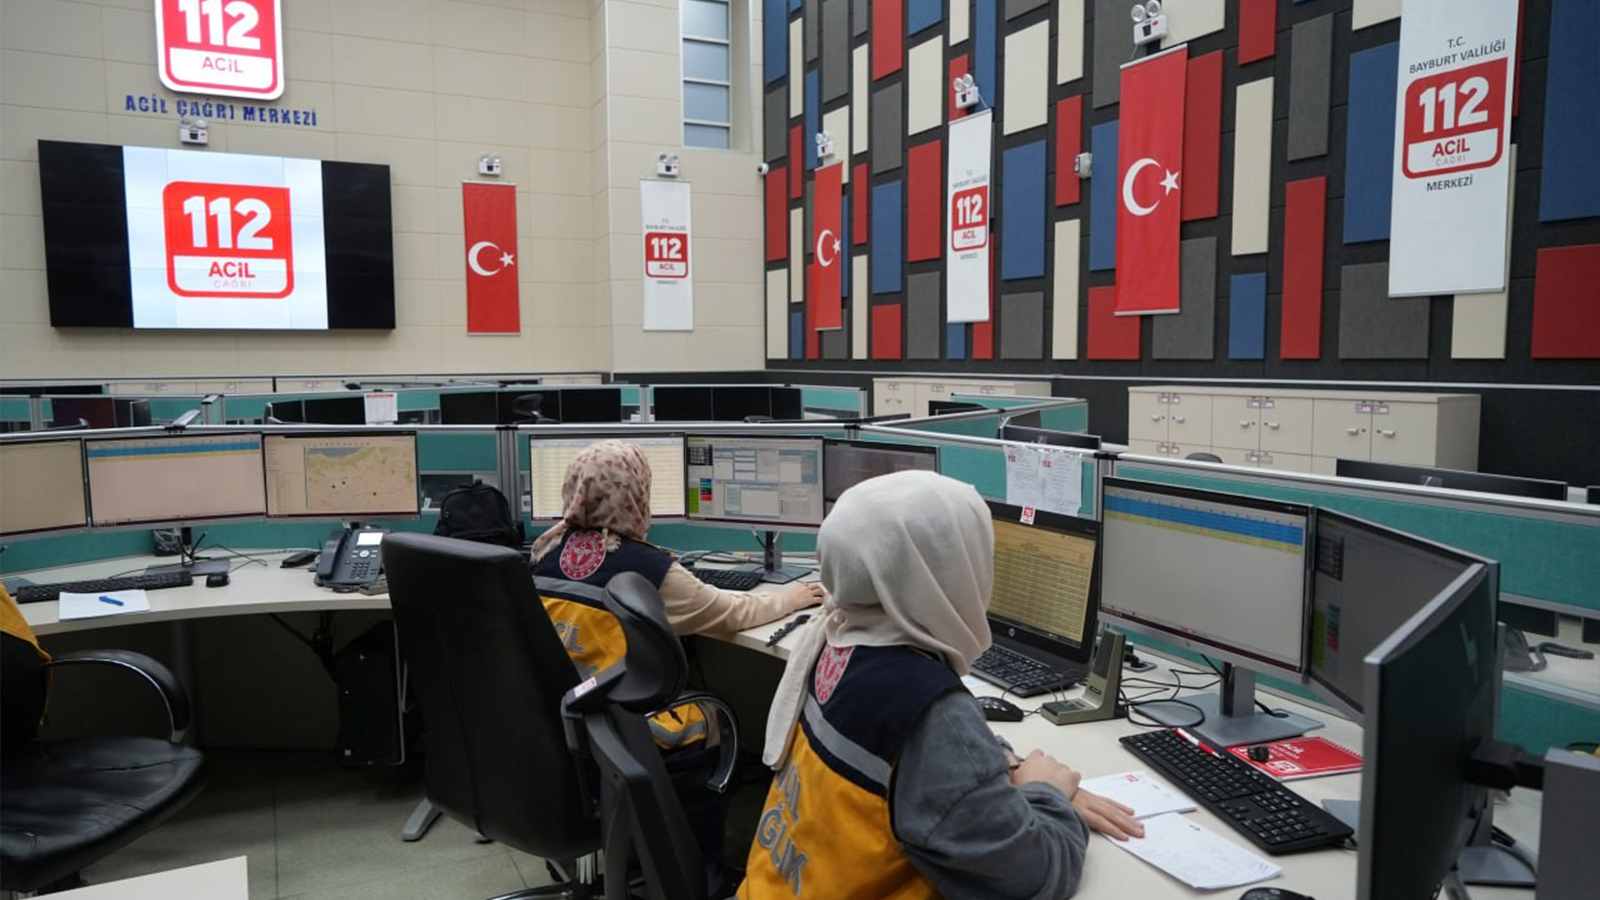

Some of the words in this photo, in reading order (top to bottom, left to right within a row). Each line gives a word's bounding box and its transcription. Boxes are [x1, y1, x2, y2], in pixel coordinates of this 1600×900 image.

[178, 0, 261, 50] 112
[1409, 53, 1457, 74] BAYBURT
[1460, 38, 1506, 61] VALİLİĞİ
[1447, 36, 1466, 48] T.C.
[125, 94, 168, 114] ACİL
[176, 98, 235, 120] ÇAĞRI
[243, 106, 317, 126] MERKEZİ
[1419, 76, 1490, 134] 112
[1426, 174, 1473, 191] MERKEZİ
[183, 195, 274, 250] 112
[957, 193, 983, 226] 112
[651, 237, 682, 259] 112
